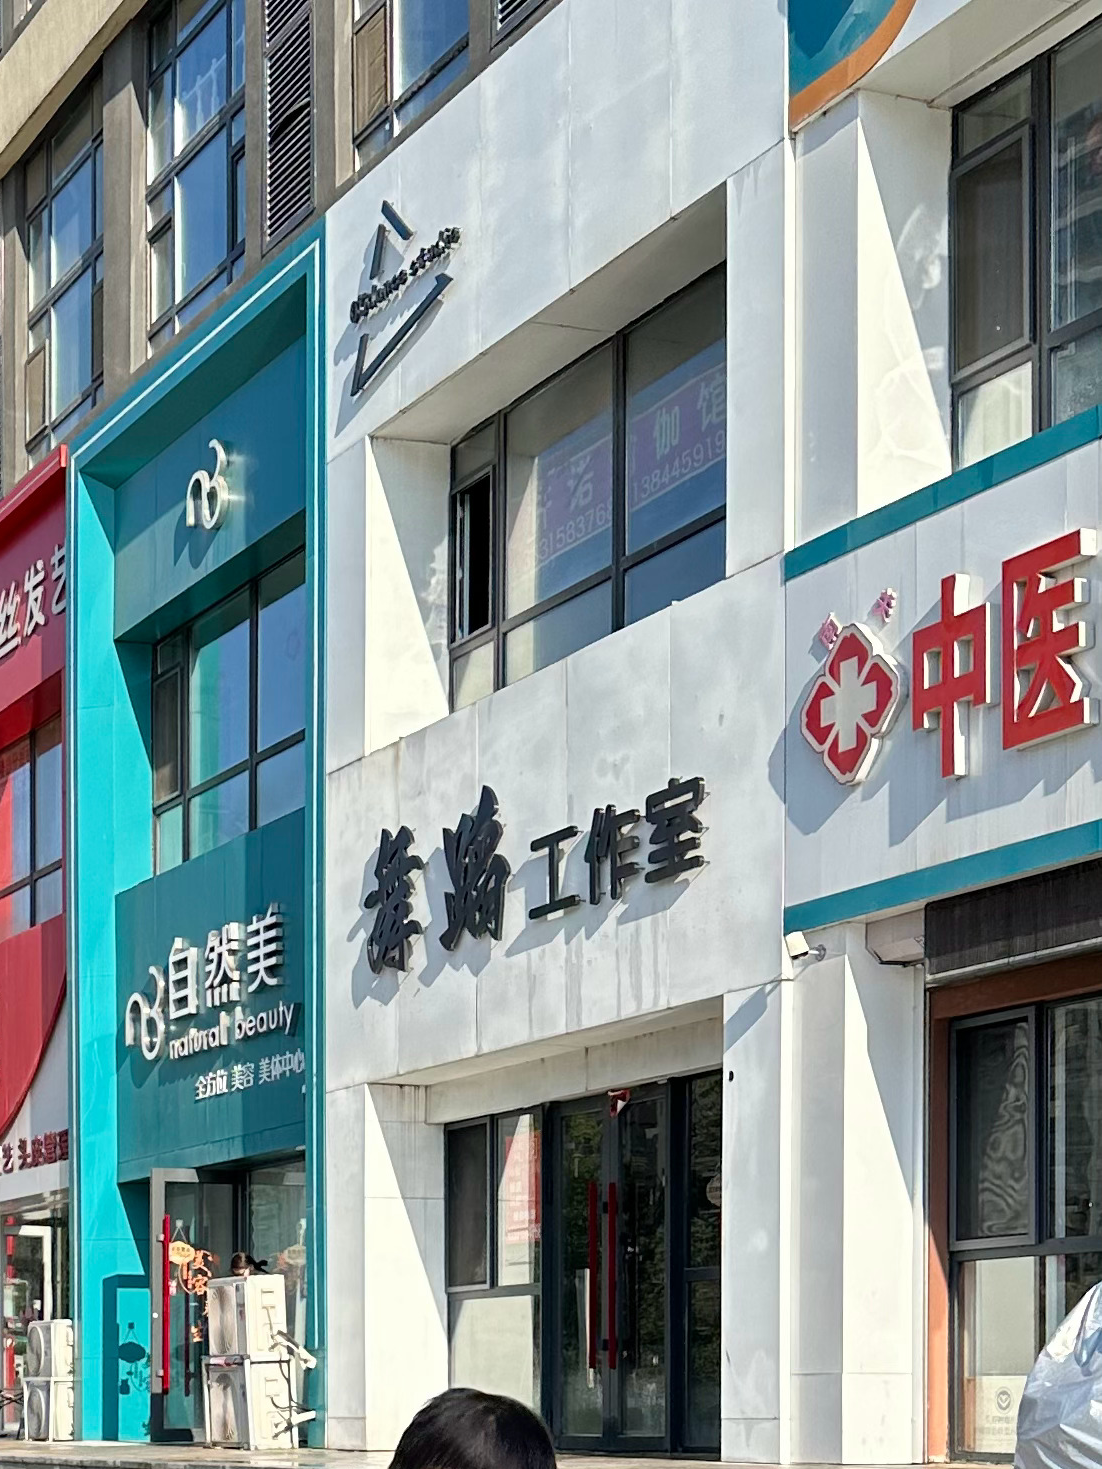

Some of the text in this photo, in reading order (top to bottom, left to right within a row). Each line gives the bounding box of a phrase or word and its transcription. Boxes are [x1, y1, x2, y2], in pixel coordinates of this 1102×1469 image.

[912, 528, 1096, 778] 中医
[364, 777, 705, 974] 舞蹈工作室
[169, 902, 283, 1019] 自然美
[170, 1001, 296, 1060] natural beauty
[195, 1048, 305, 1100] 全方位 美容 美体中心
